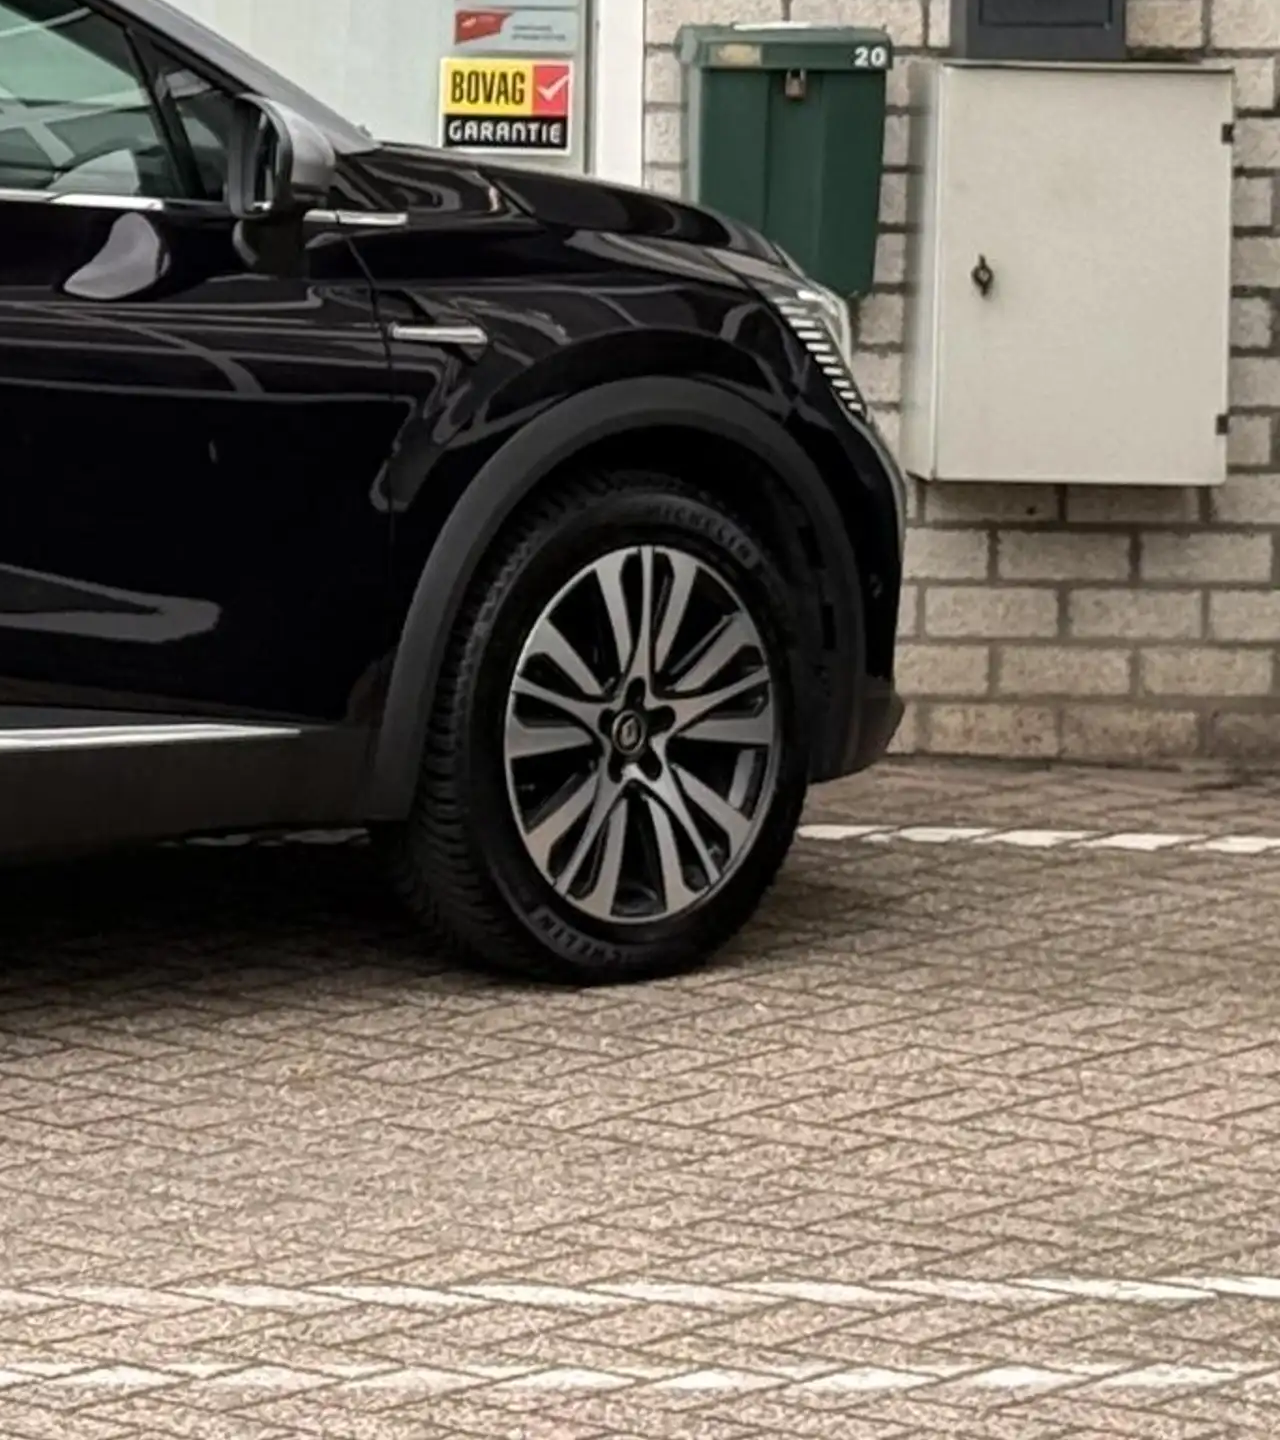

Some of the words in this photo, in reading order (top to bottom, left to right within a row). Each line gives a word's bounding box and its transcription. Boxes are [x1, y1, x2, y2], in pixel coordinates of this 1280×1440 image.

[853, 46, 887, 68] 20
[450, 70, 526, 107] BOVAG
[448, 119, 563, 145] GARANTIE
